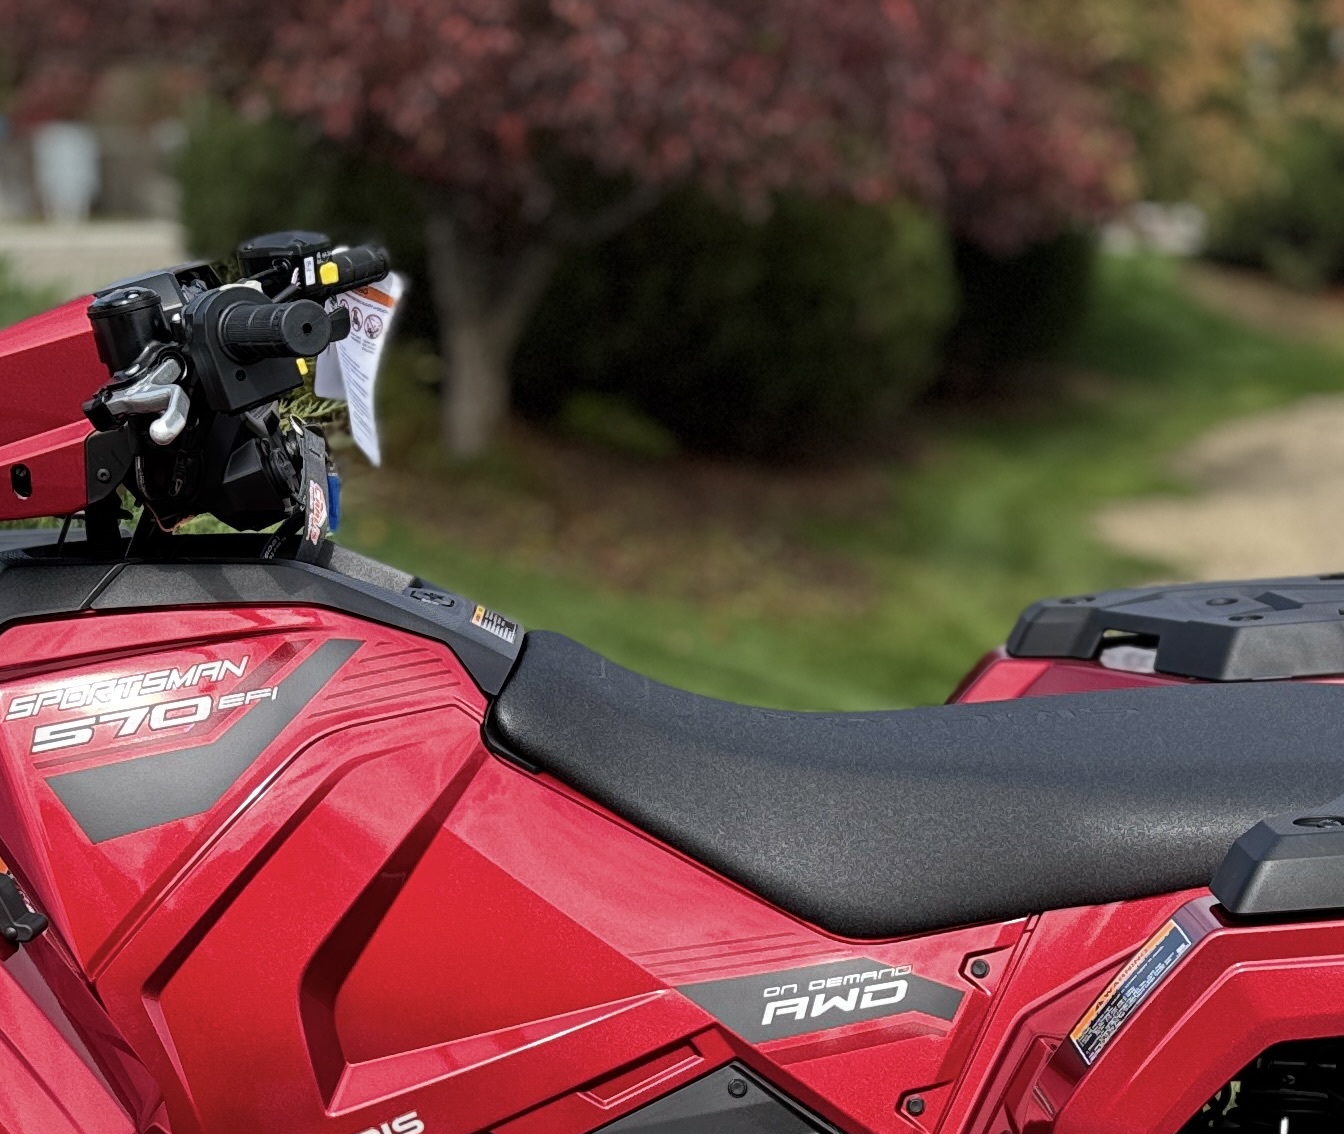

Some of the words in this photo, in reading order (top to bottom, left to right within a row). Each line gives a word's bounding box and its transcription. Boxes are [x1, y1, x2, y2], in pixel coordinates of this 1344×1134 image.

[5, 655, 251, 722] SPORTSMAN
[31, 694, 214, 755] 570
[217, 686, 280, 711] EFI
[763, 983, 798, 998] ON
[808, 964, 913, 991] DEMAND
[1103, 948, 1149, 998] WARNING
[761, 979, 909, 1026] AWD
